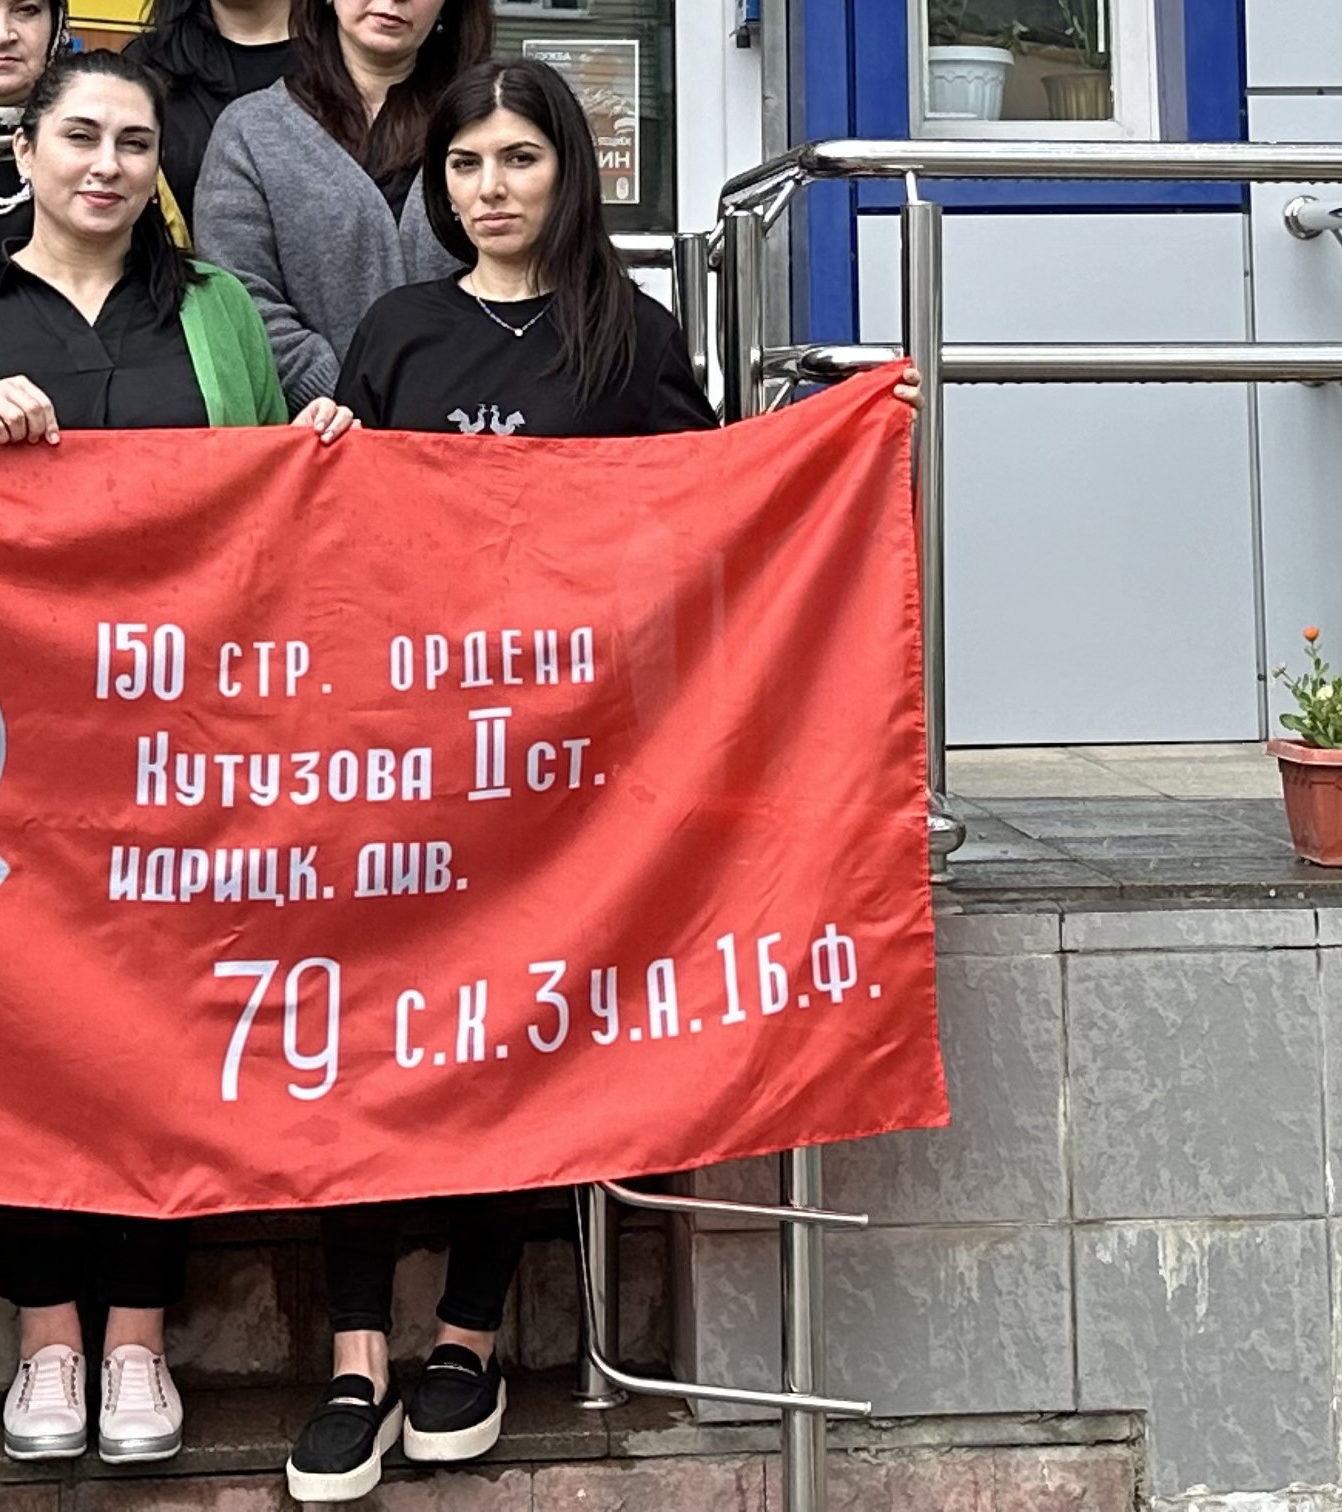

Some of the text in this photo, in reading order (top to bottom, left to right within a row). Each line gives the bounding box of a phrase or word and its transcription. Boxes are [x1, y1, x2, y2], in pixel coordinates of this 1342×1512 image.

[95, 621, 596, 701] 150 СТР. ОРДЕНА
[108, 840, 469, 908] ИДРИЦК. ДИВ.
[213, 956, 342, 1103] 79
